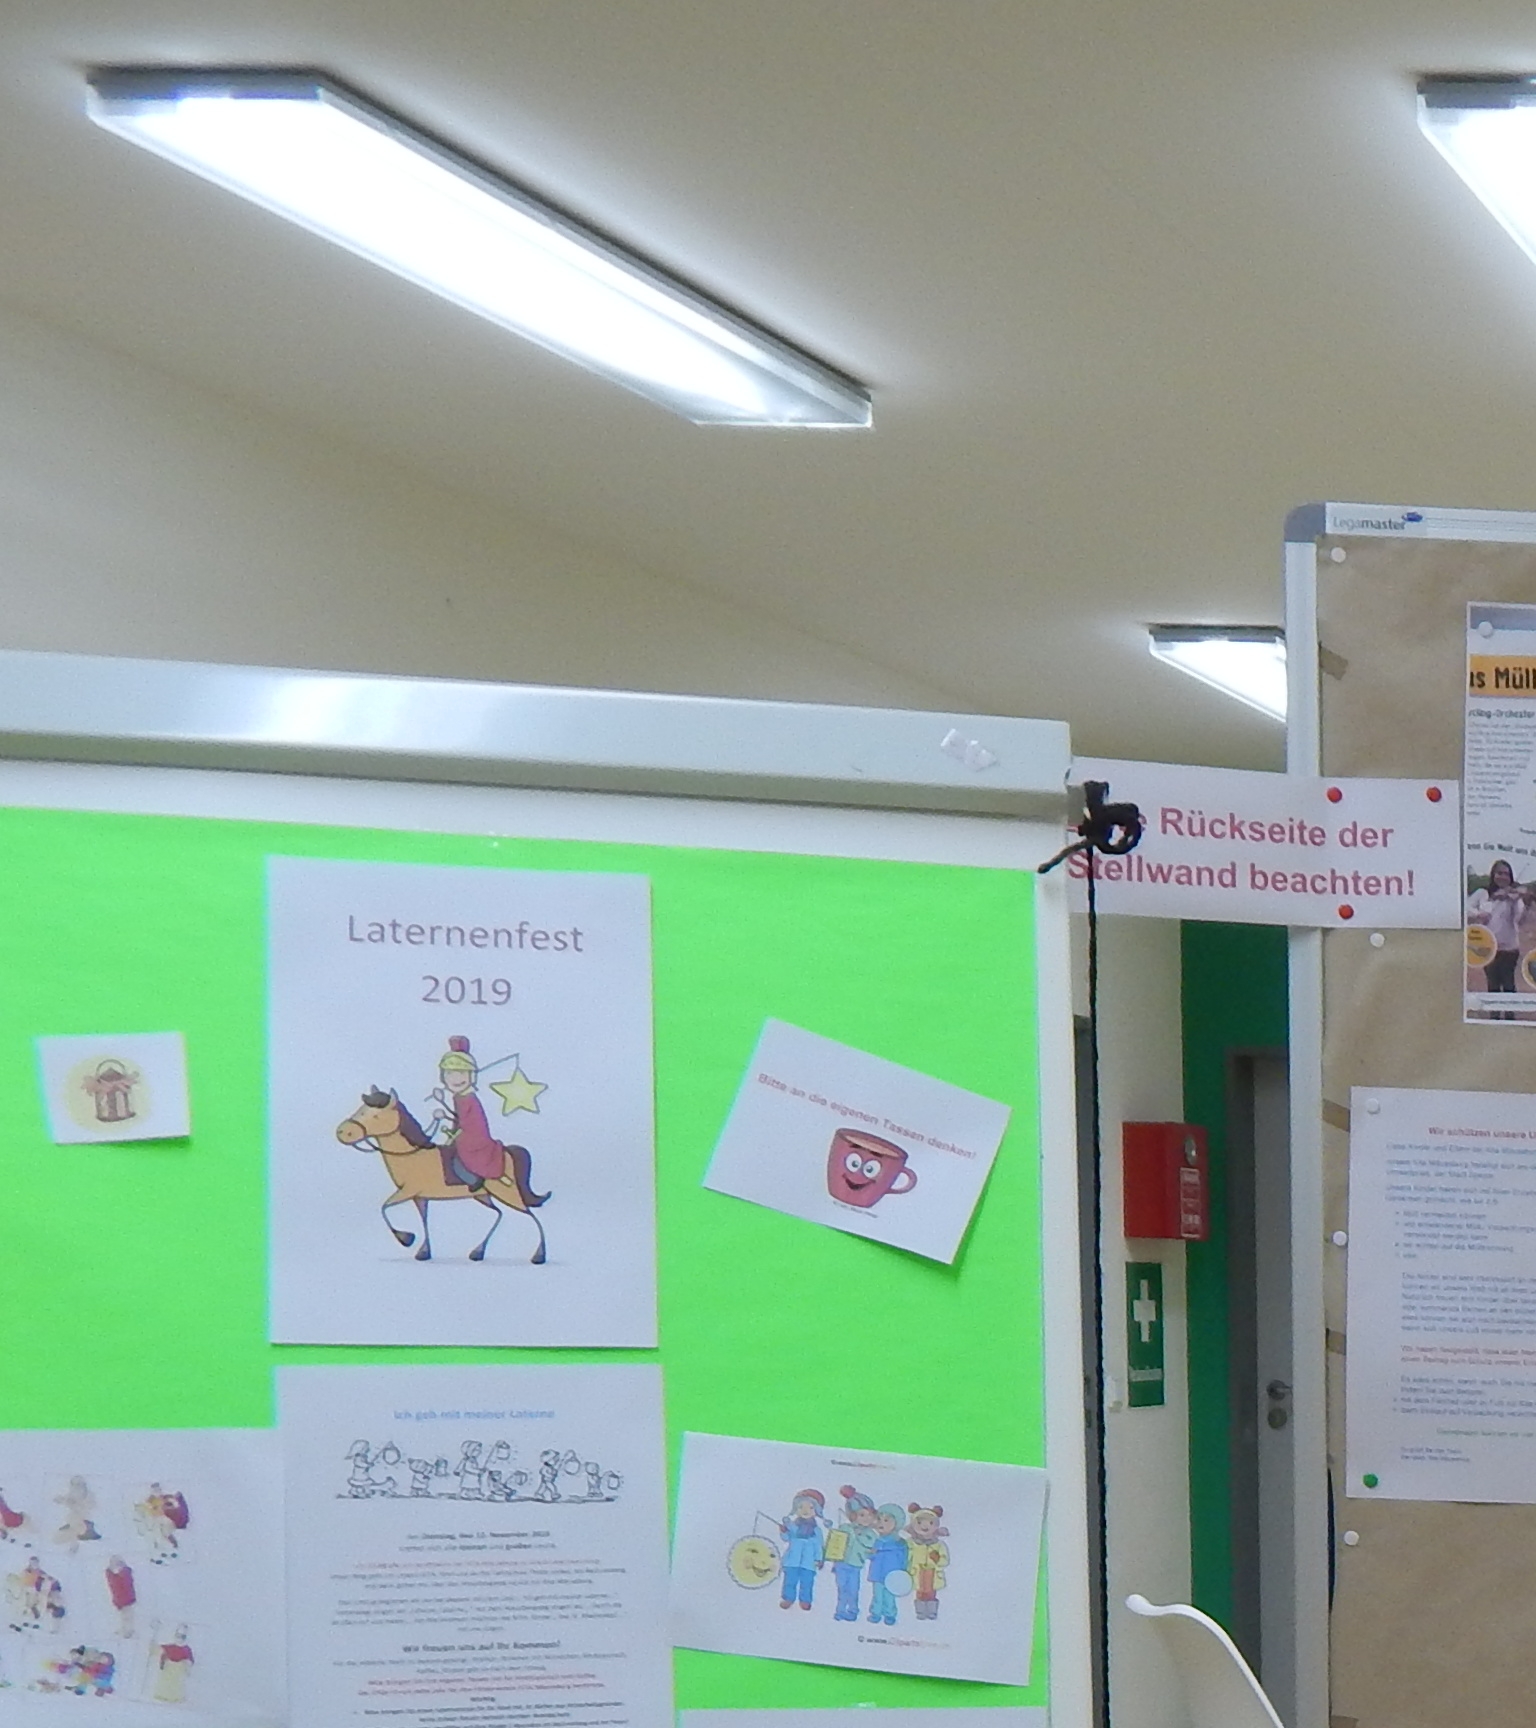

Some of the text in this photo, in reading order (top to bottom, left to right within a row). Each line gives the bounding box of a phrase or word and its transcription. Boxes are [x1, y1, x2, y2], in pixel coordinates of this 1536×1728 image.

[1332, 516, 1405, 531] Legamaster
[1161, 806, 1327, 848] Rückseite
[1339, 821, 1395, 849] der
[1250, 862, 1415, 897] beachten!
[348, 914, 584, 952] Laternenfest
[422, 974, 513, 1006] 2019
[758, 1072, 788, 1093] Bitte
[883, 1117, 925, 1142] Tassen
